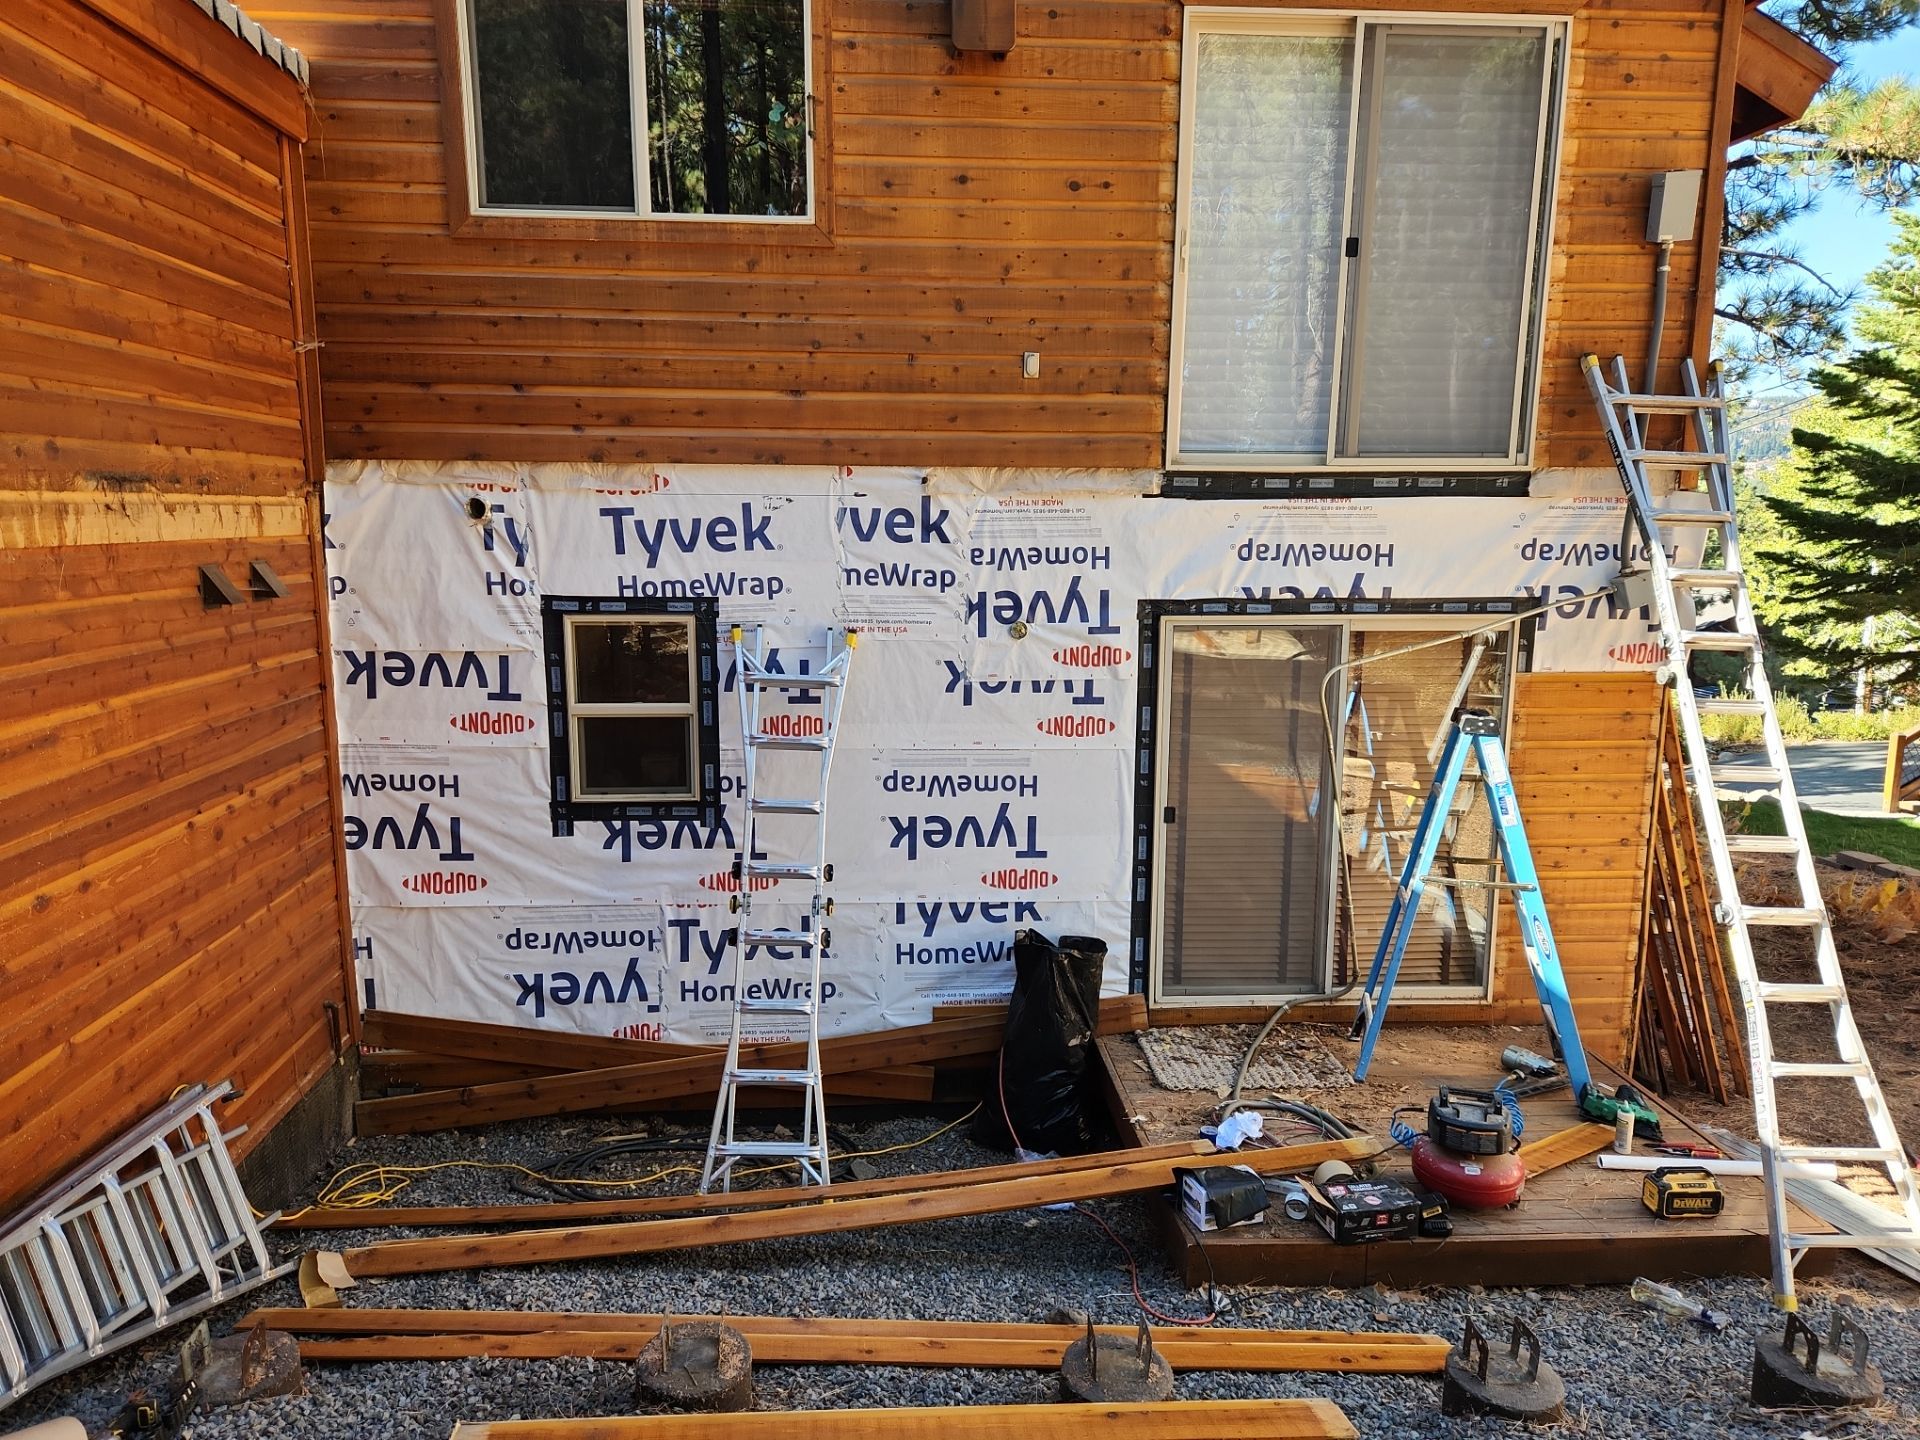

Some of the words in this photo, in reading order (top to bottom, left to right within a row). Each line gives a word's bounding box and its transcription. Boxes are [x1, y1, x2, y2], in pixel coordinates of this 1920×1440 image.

[600, 502, 776, 568] Tyvek
[970, 546, 1111, 571] HomeWra
[1237, 538, 1394, 568] HomeWrap
[617, 571, 785, 600] HomeWrap
[1061, 645, 1123, 668] DUPONT
[342, 650, 522, 702] Tyvek
[459, 711, 525, 735] DUPONT
[761, 714, 823, 737] DUPONT
[1046, 715, 1106, 738] DUPONT
[882, 769, 1038, 798] HomeWrap
[888, 802, 1048, 861] Tyvek
[411, 871, 478, 895] DUPONT
[708, 871, 779, 893] DUONT
[989, 868, 1049, 890] DUPONT
